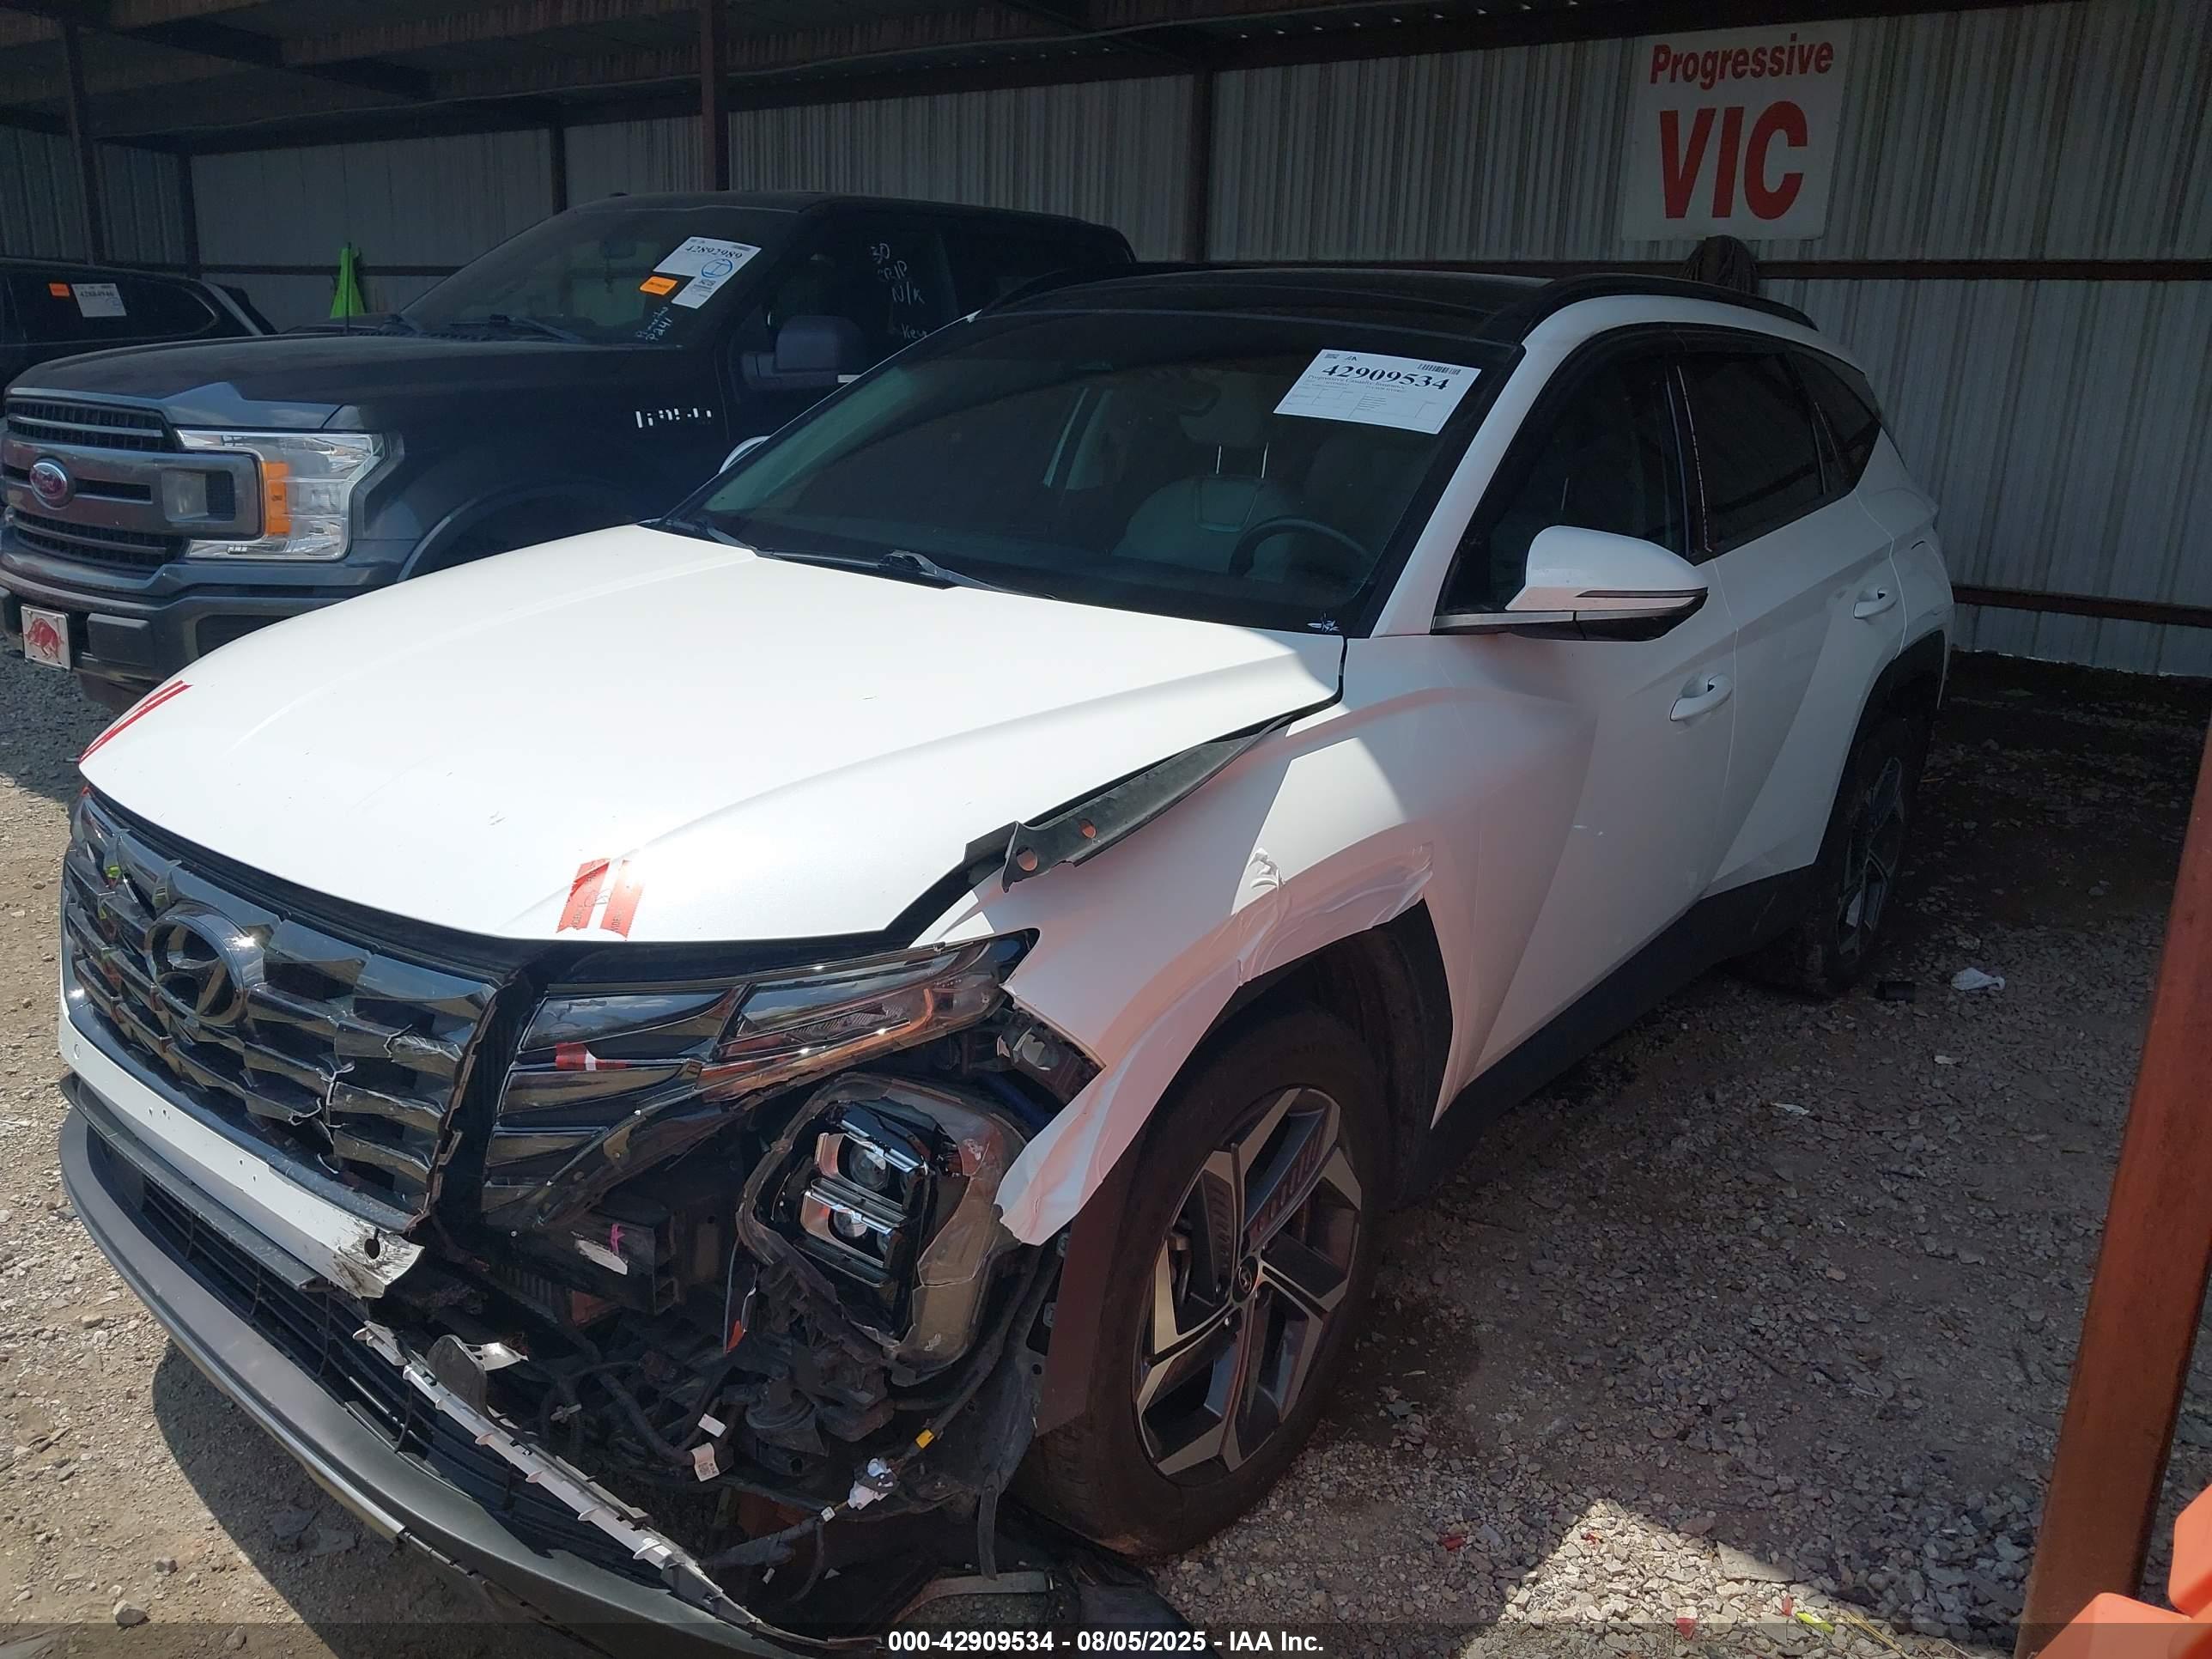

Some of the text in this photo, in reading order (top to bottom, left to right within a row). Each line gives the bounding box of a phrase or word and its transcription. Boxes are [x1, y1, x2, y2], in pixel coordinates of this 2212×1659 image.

[1650, 33, 1833, 90] Progressive
[1659, 100, 1808, 220] VIC
[1322, 364, 1450, 390] 42909534
